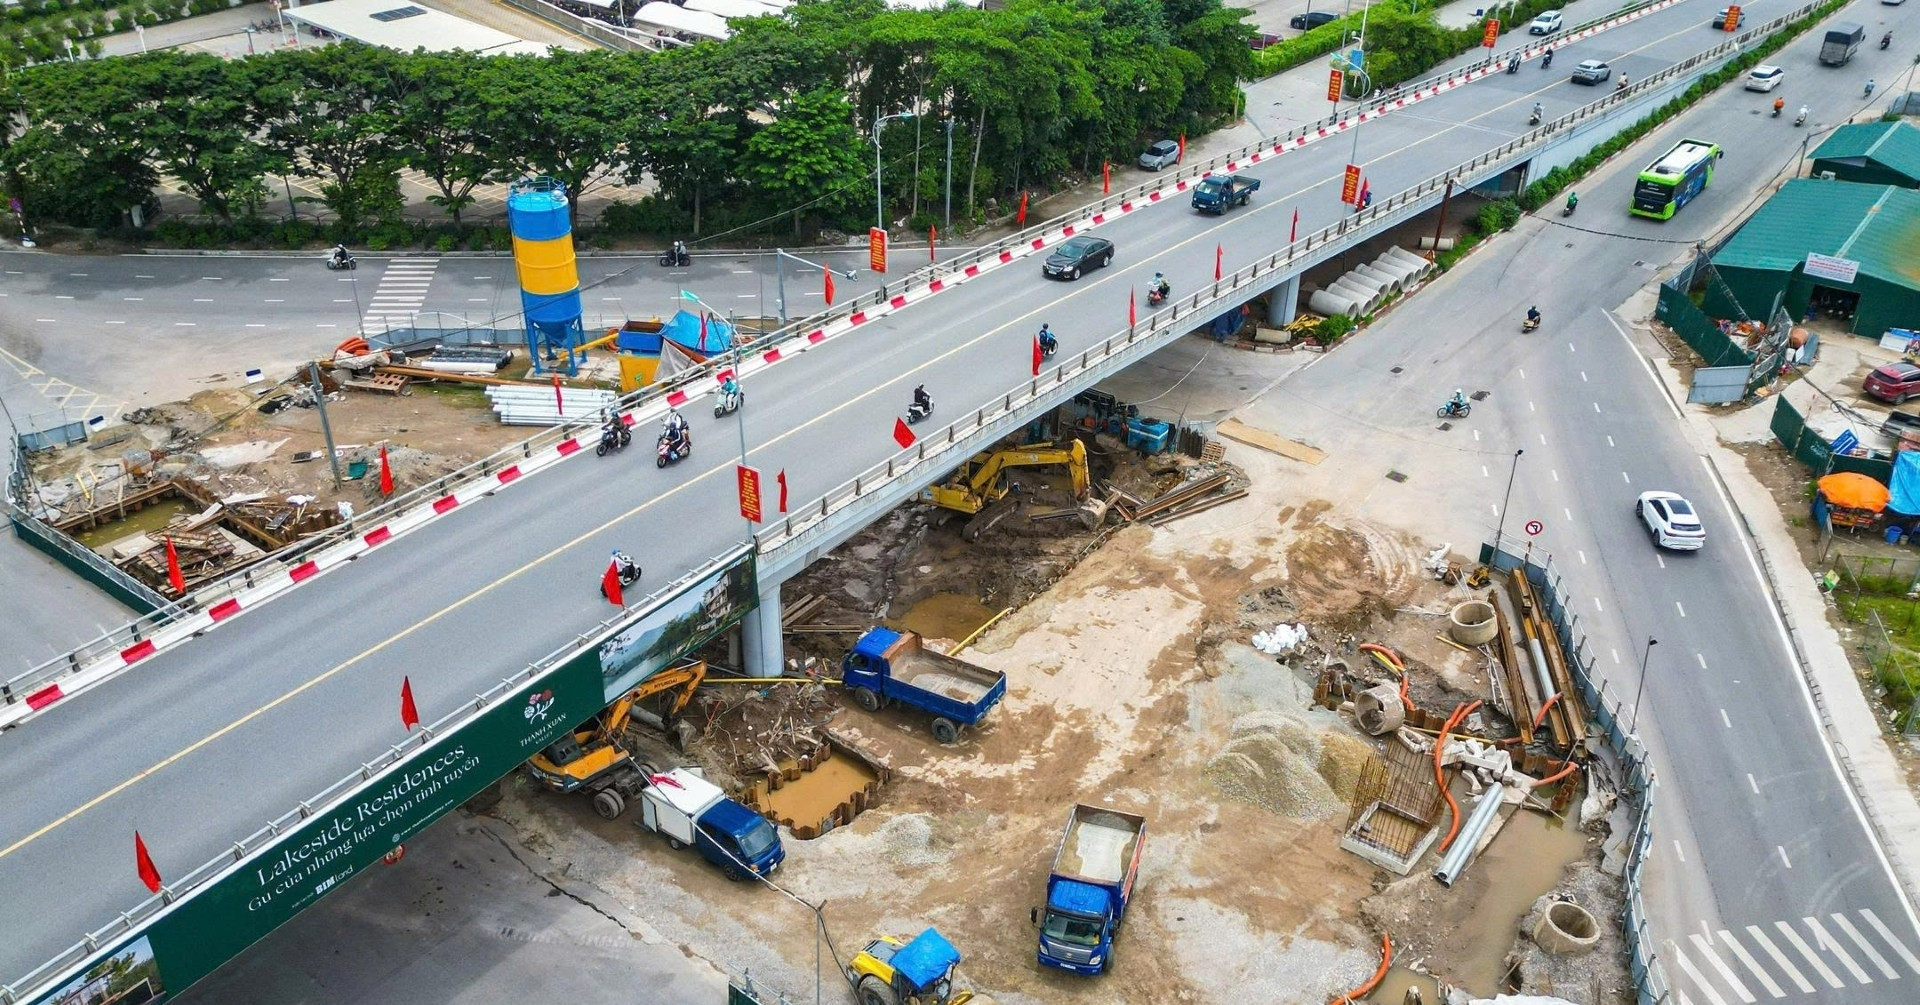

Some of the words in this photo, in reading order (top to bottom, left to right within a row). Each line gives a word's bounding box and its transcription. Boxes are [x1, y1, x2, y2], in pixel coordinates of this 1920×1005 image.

[653, 677, 678, 689] HYUNDAI
[520, 726, 546, 747] THANH
[258, 817, 354, 887] Lakeside
[357, 744, 464, 822] Residences
[248, 892, 272, 911] Gu
[275, 873, 303, 894] của
[306, 839, 353, 875] những
[353, 824, 376, 844] lựa
[379, 799, 413, 827] chọn
